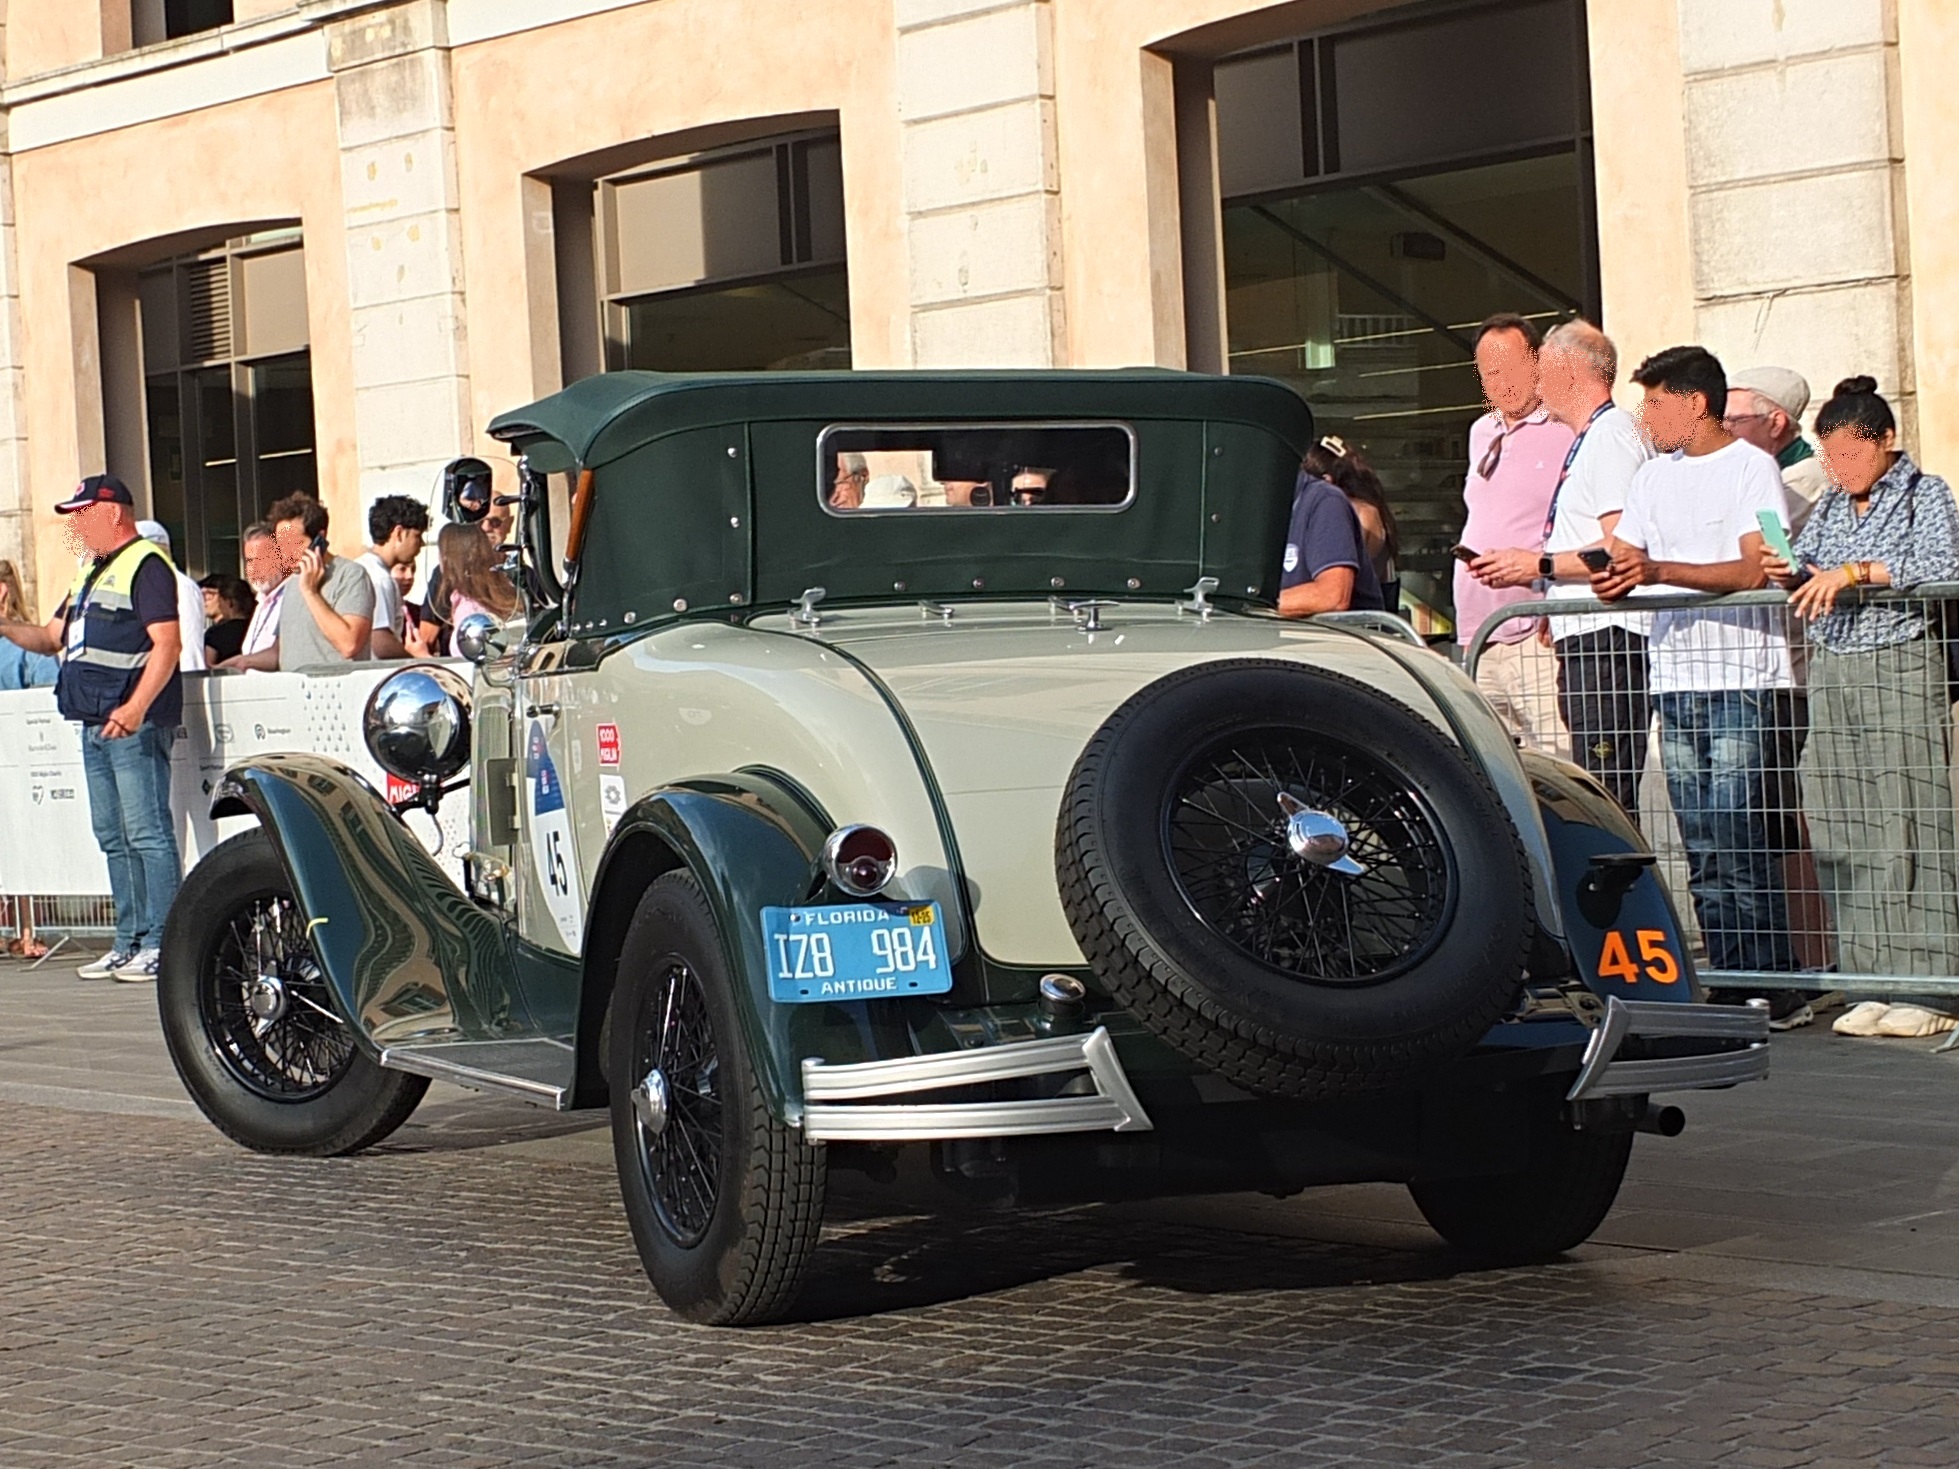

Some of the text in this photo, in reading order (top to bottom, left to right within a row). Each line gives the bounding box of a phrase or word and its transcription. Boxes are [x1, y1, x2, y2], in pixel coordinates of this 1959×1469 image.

[546, 830, 568, 896] 45
[804, 909, 890, 926] FLORIDA
[774, 926, 936, 979] IZ8 984
[1598, 929, 1679, 984] 45
[821, 977, 897, 995] ANTIQUE
